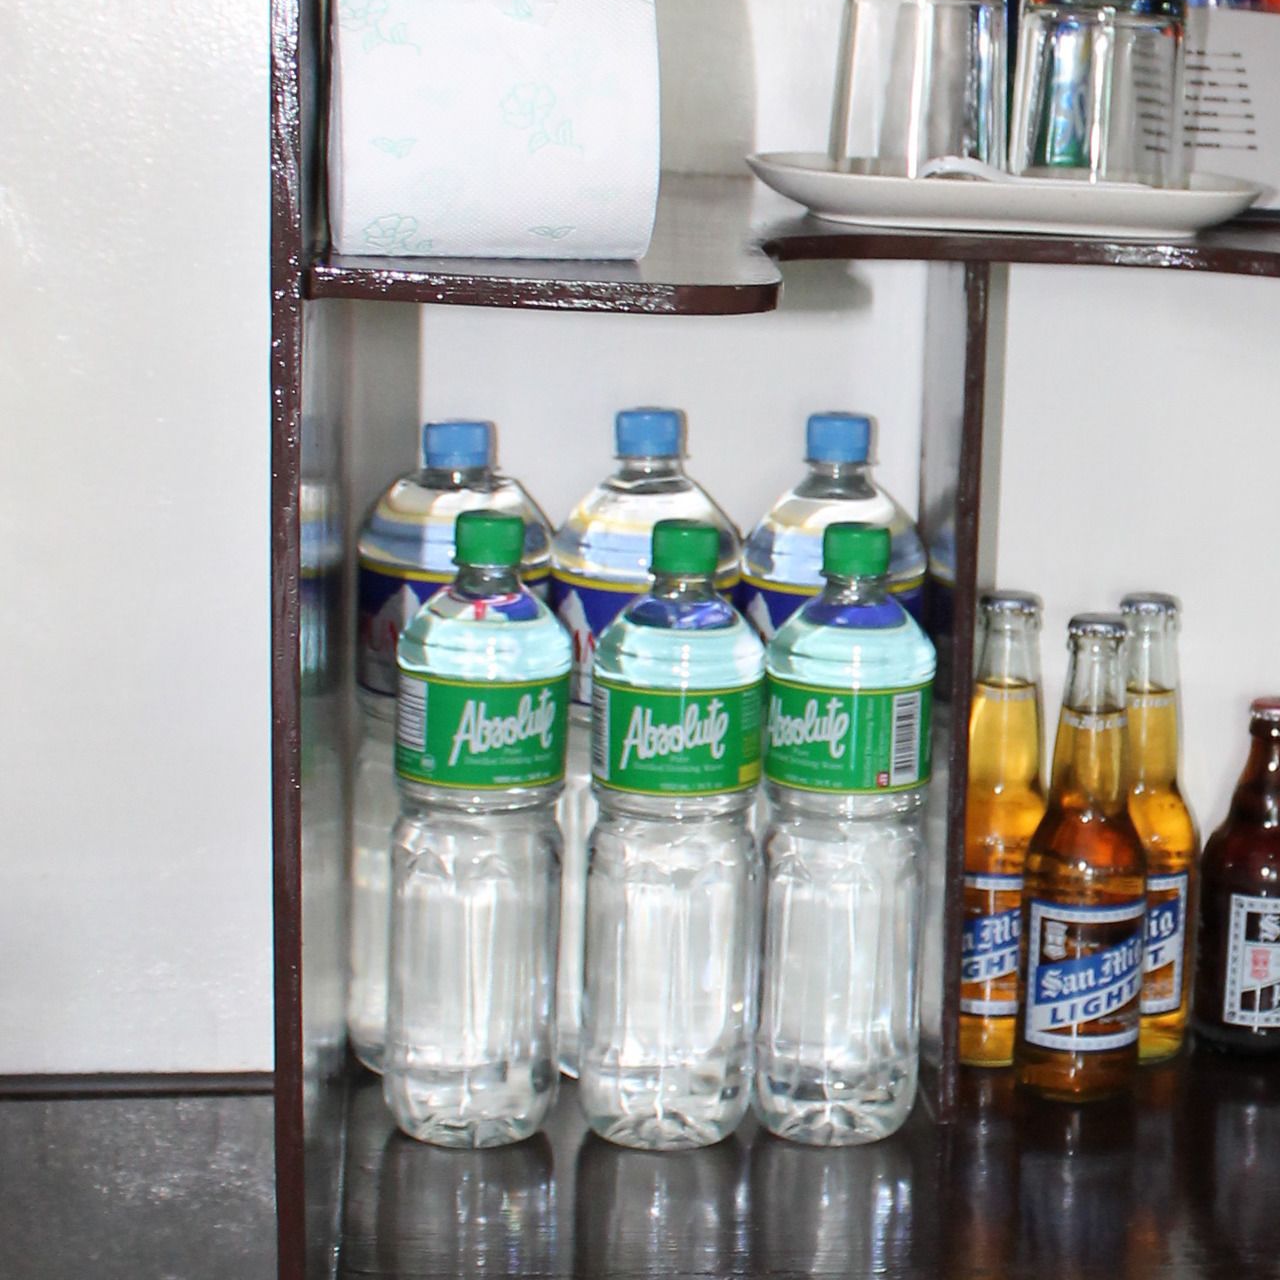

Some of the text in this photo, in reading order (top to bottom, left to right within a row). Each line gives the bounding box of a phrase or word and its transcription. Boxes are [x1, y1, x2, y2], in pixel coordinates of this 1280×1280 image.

[448, 687, 557, 766] Absolute
[620, 698, 729, 770] Absolute
[1041, 969, 1096, 998] San
[1051, 977, 1137, 1024] LIGHT
